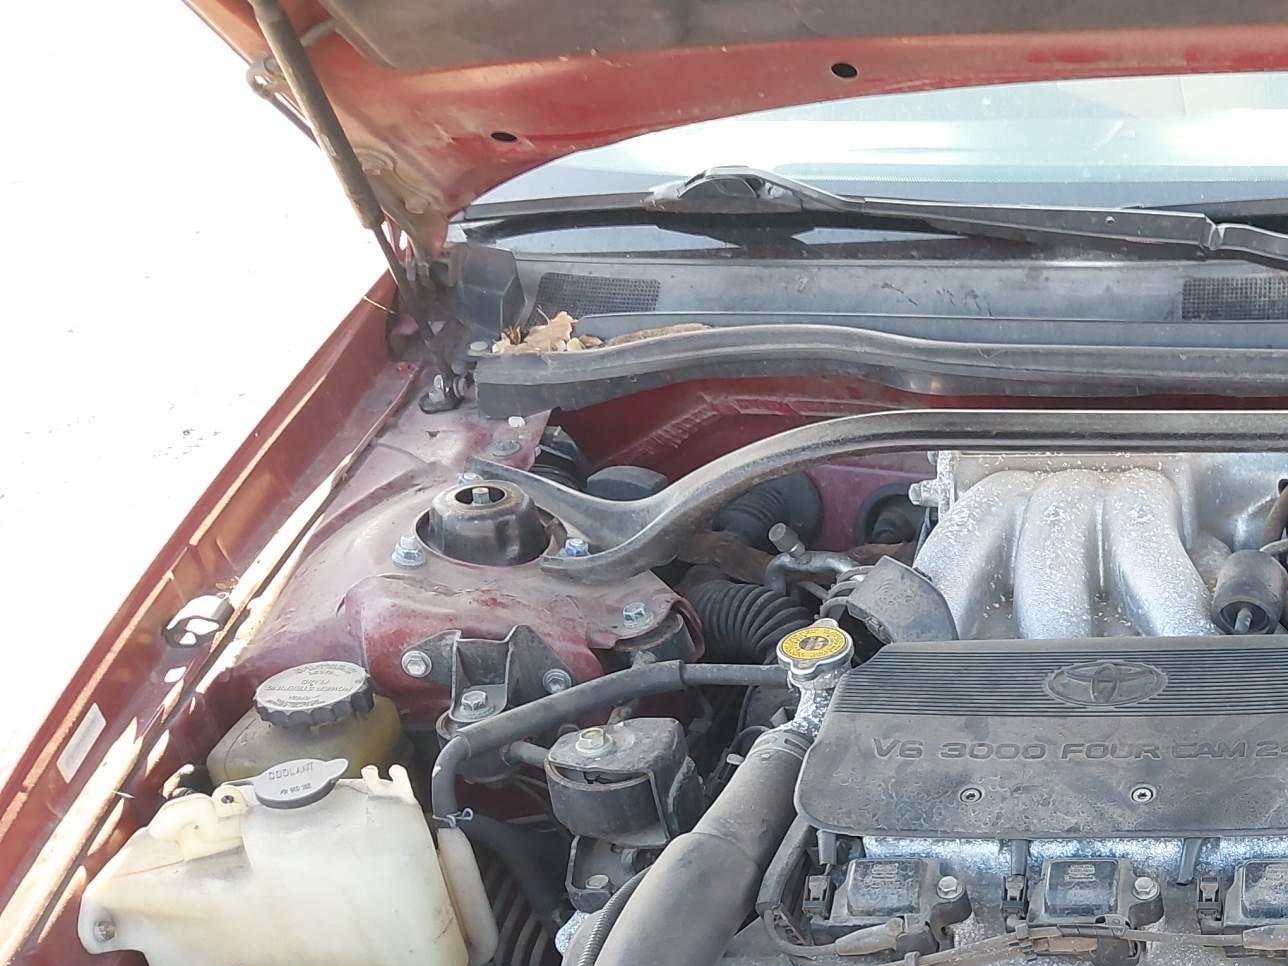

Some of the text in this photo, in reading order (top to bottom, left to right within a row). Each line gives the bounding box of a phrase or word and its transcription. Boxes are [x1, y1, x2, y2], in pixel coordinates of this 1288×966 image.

[873, 738, 924, 759] V6
[940, 741, 1047, 760] 3000
[1060, 741, 1162, 760] FOUR
[1171, 740, 1247, 759] CAM
[268, 762, 314, 780] COOLANT
